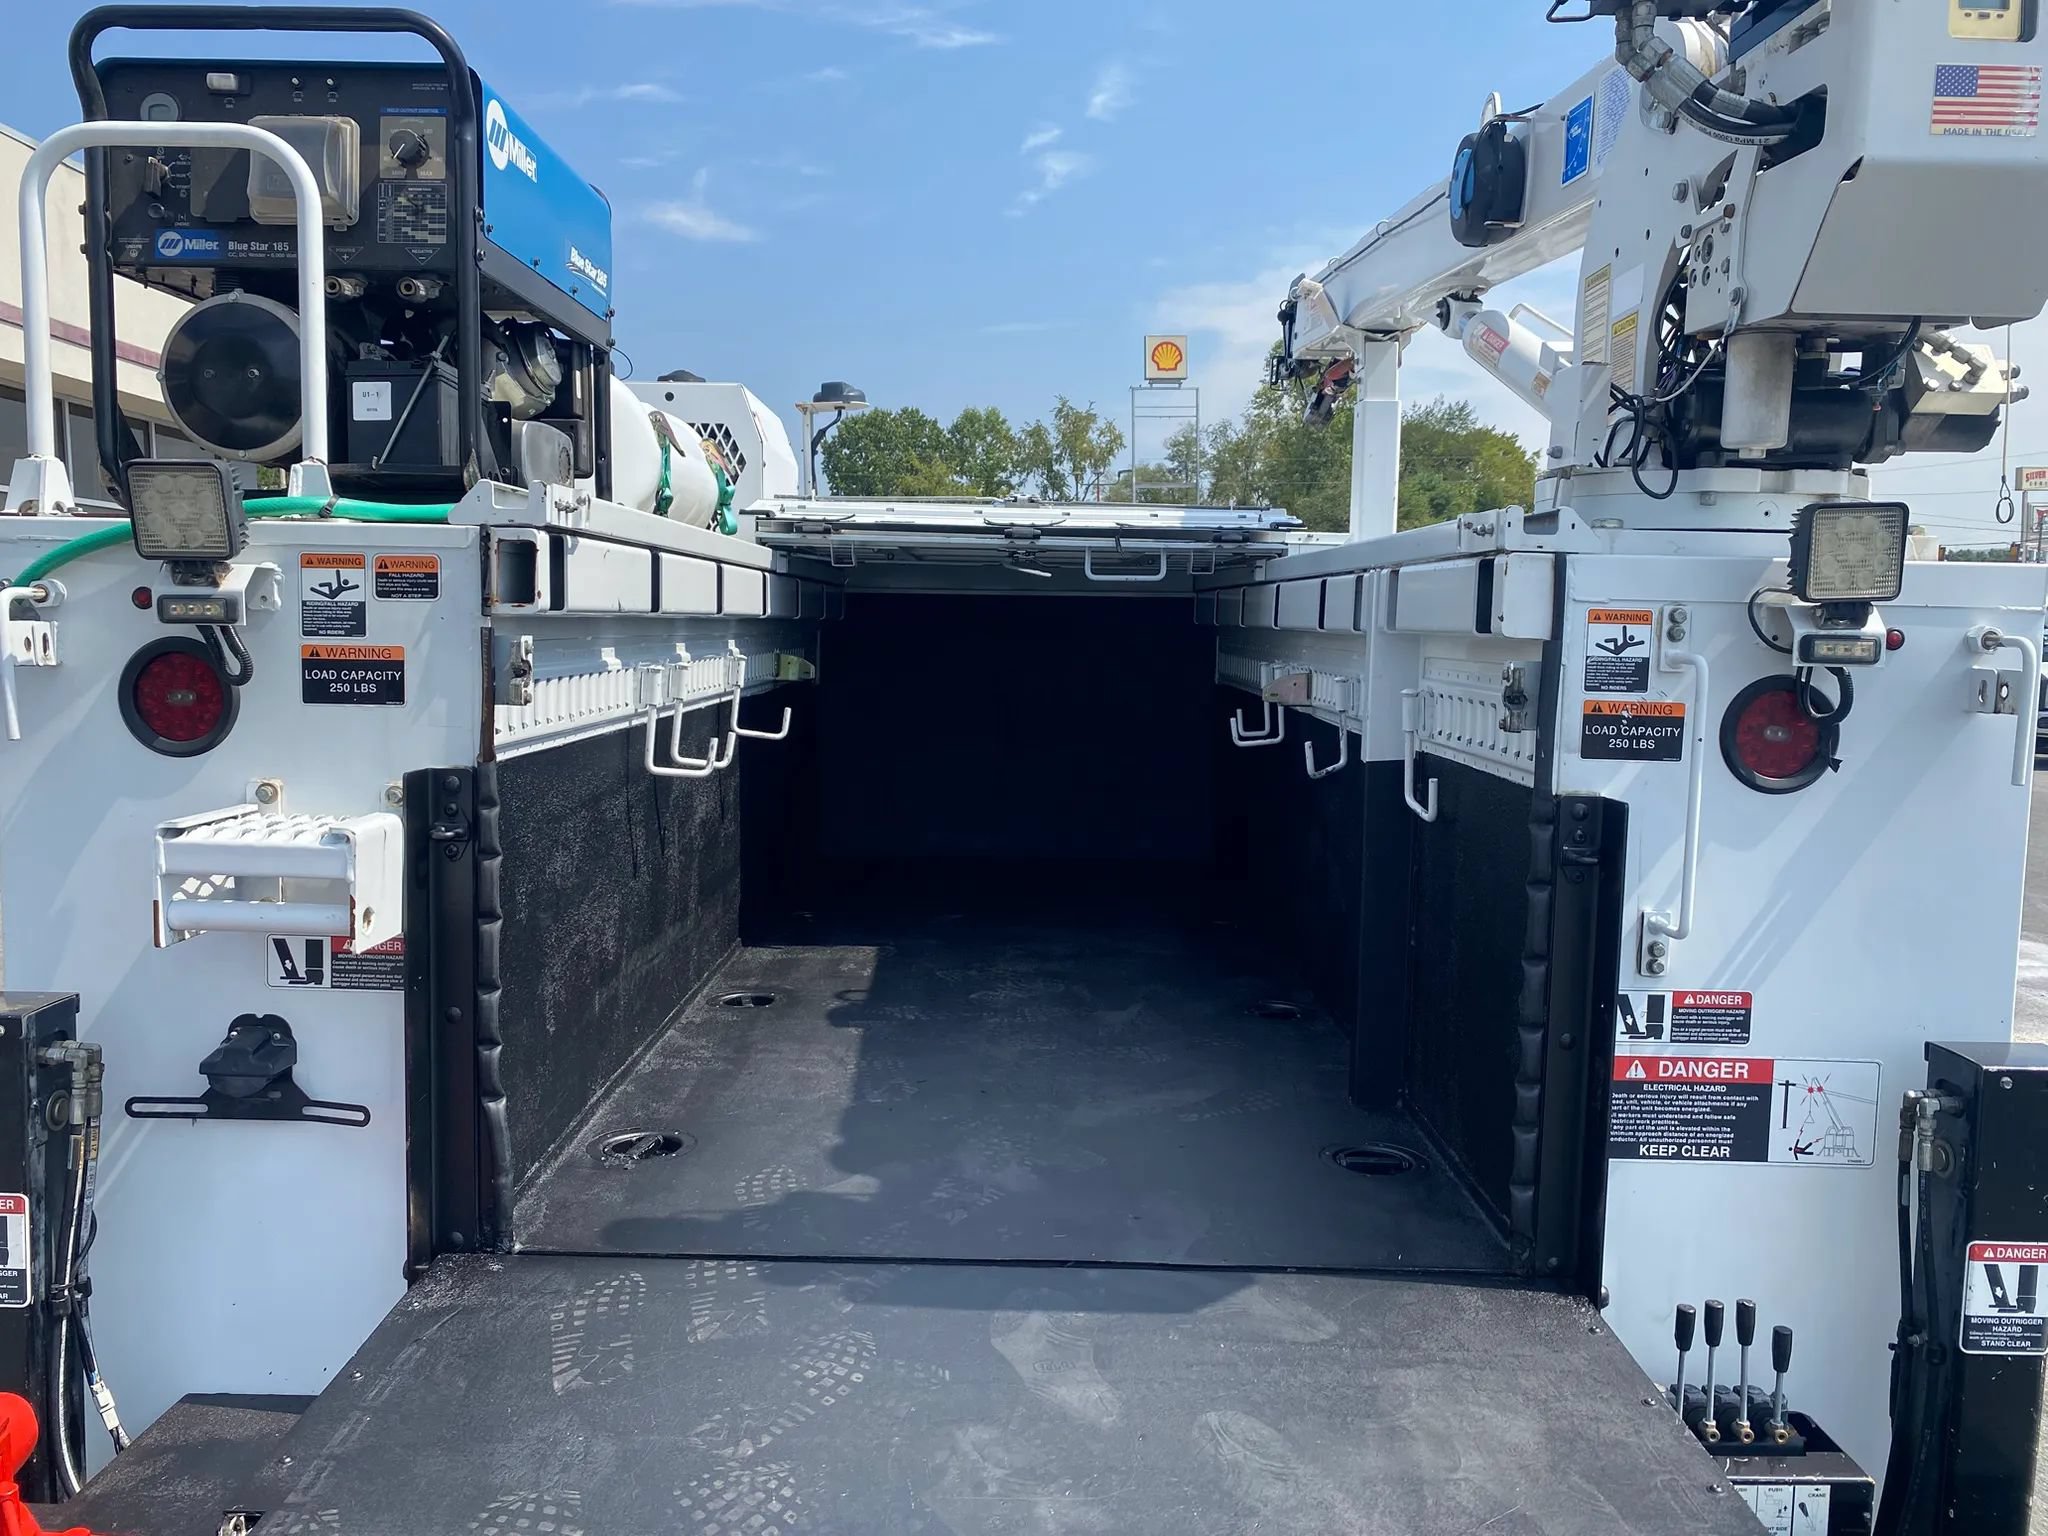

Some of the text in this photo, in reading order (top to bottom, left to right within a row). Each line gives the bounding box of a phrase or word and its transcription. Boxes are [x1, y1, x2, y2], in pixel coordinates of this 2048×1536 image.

[507, 131, 537, 183] Miller
[184, 239, 219, 250] Miller
[228, 241, 289, 251] Blue Star 185
[570, 246, 585, 271] Blue
[584, 258, 598, 280] Star
[317, 557, 362, 566] WARNING
[390, 560, 435, 569] WARNING
[1605, 613, 1648, 622] WARNING
[325, 648, 391, 659] WARNING
[305, 670, 401, 680] LOAD CAPACITY
[330, 683, 376, 692] 250 LBS
[1608, 703, 1672, 715] WARNING
[1585, 725, 1680, 736] LOAD CAPACITY
[1609, 739, 1655, 748] 250 LBS
[1696, 995, 1742, 1005] DANGER
[1658, 1061, 1749, 1079] DANGER
[1640, 1145, 1730, 1157] KEEP CLEAR
[1996, 1248, 2047, 1259] DANGER
